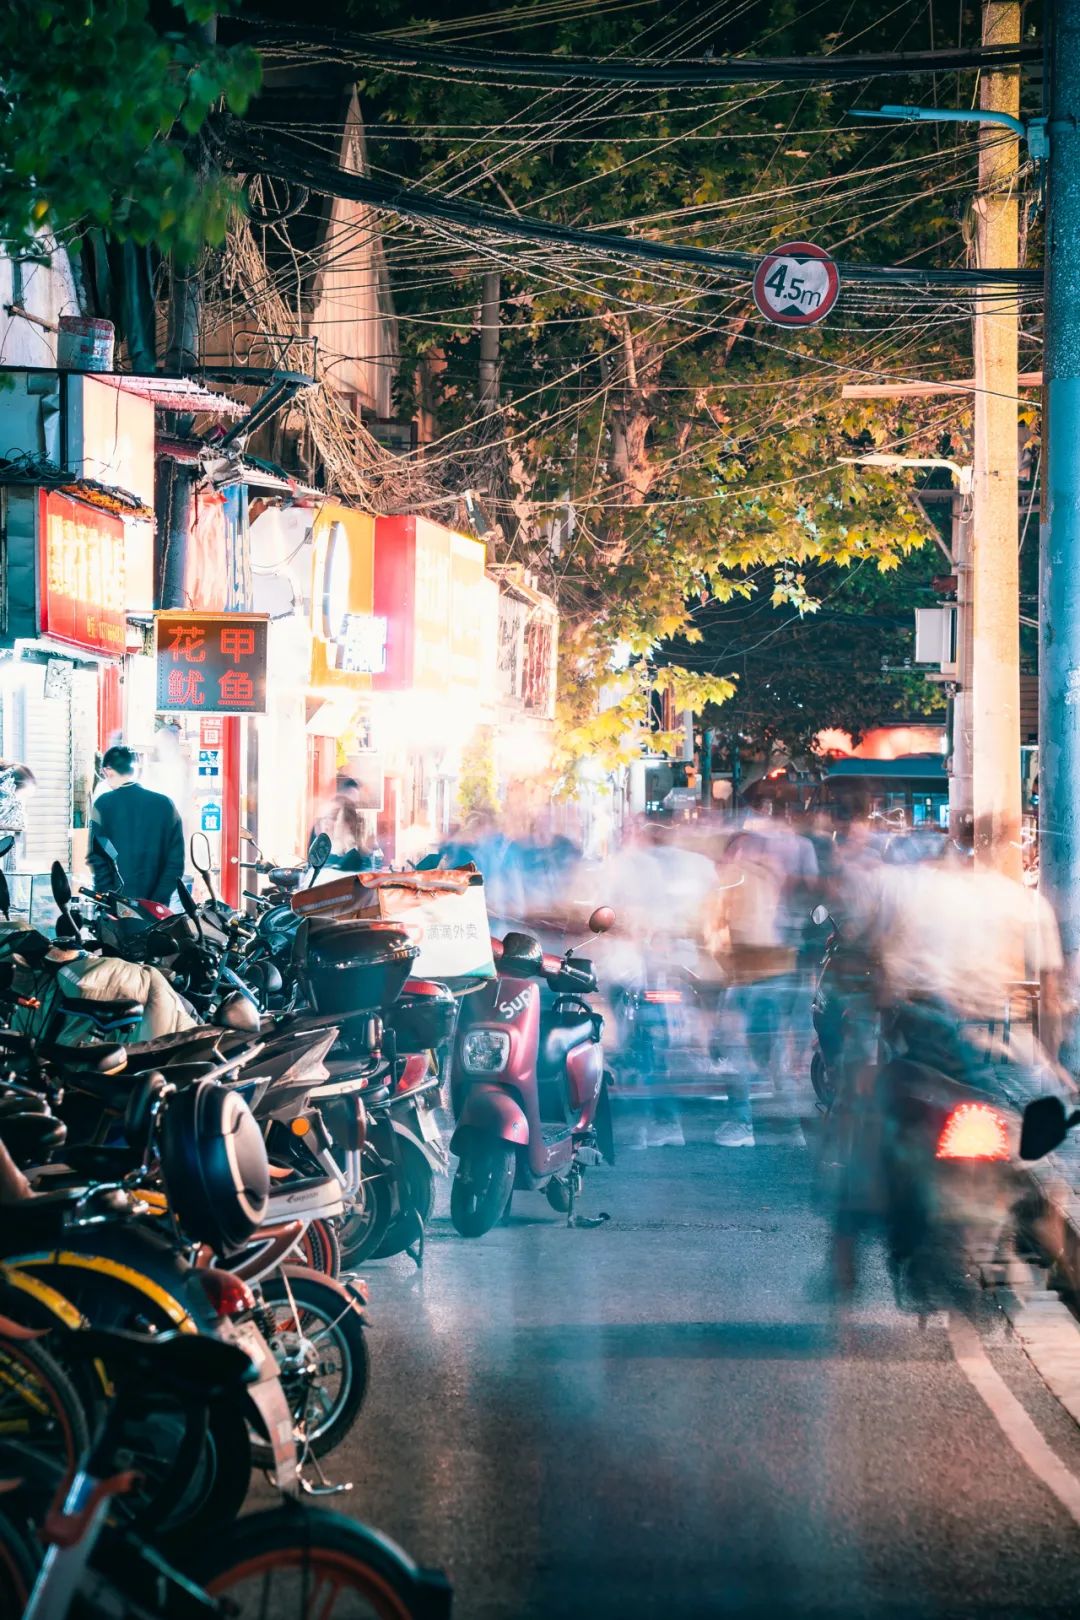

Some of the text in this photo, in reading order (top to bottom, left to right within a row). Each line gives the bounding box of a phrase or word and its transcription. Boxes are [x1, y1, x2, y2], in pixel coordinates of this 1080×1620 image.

[764, 264, 822, 307] 4.5m
[168, 625, 255, 664] 花甲
[167, 669, 256, 706] 鱿鱼
